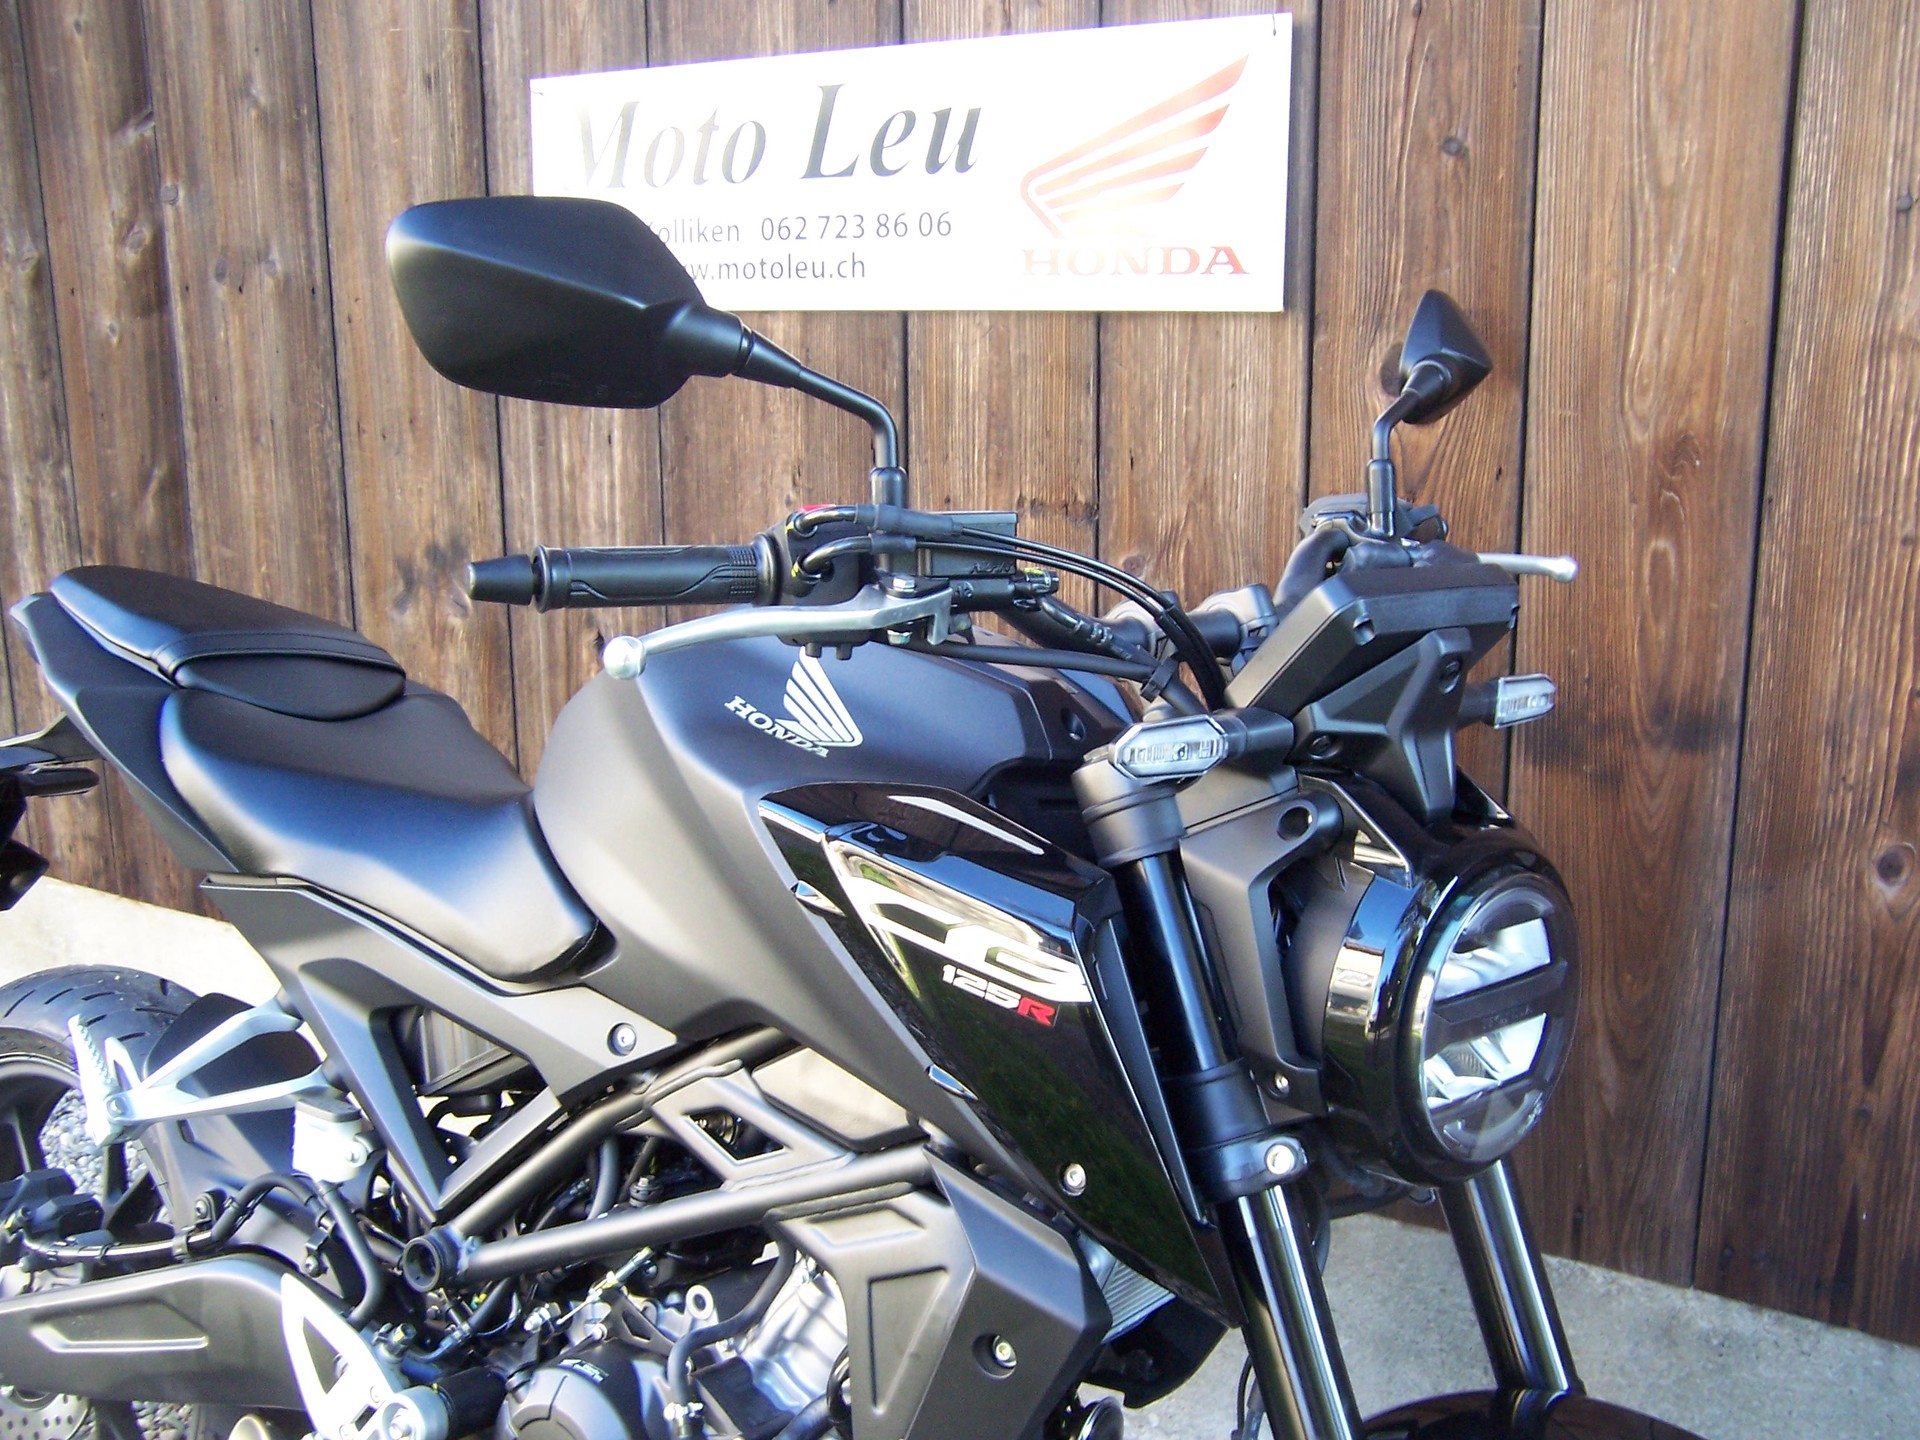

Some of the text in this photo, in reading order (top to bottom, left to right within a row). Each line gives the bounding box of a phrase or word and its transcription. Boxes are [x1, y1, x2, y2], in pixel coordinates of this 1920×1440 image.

[566, 83, 982, 190] Moto Leu
[650, 211, 951, 243] olliken 062 723 86 06
[684, 252, 865, 280] w.motoleu.ch
[1022, 246, 1250, 275] HONDA
[724, 695, 829, 758] HONDA
[942, 964, 1056, 1027] 125R
